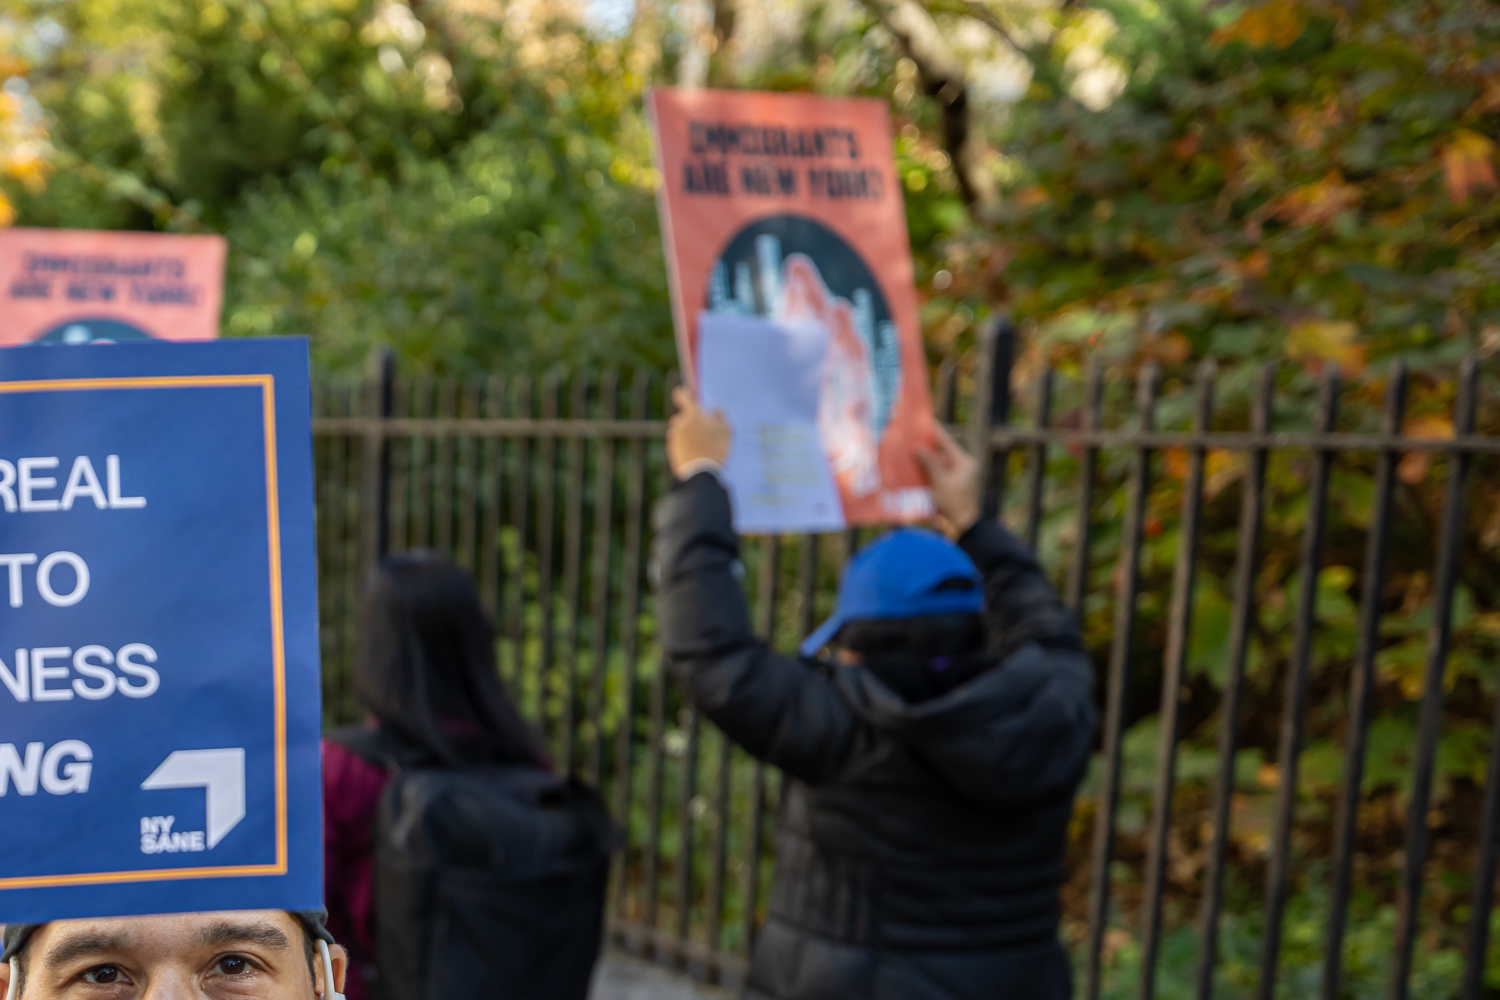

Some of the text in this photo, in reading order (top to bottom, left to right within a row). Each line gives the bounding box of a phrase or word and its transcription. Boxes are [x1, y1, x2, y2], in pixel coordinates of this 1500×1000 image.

[688, 121, 858, 159] IMMIGRANTS
[684, 161, 729, 195] ARE
[741, 165, 795, 196] NEW
[140, 815, 175, 835] NY
[140, 831, 205, 854] SANE
